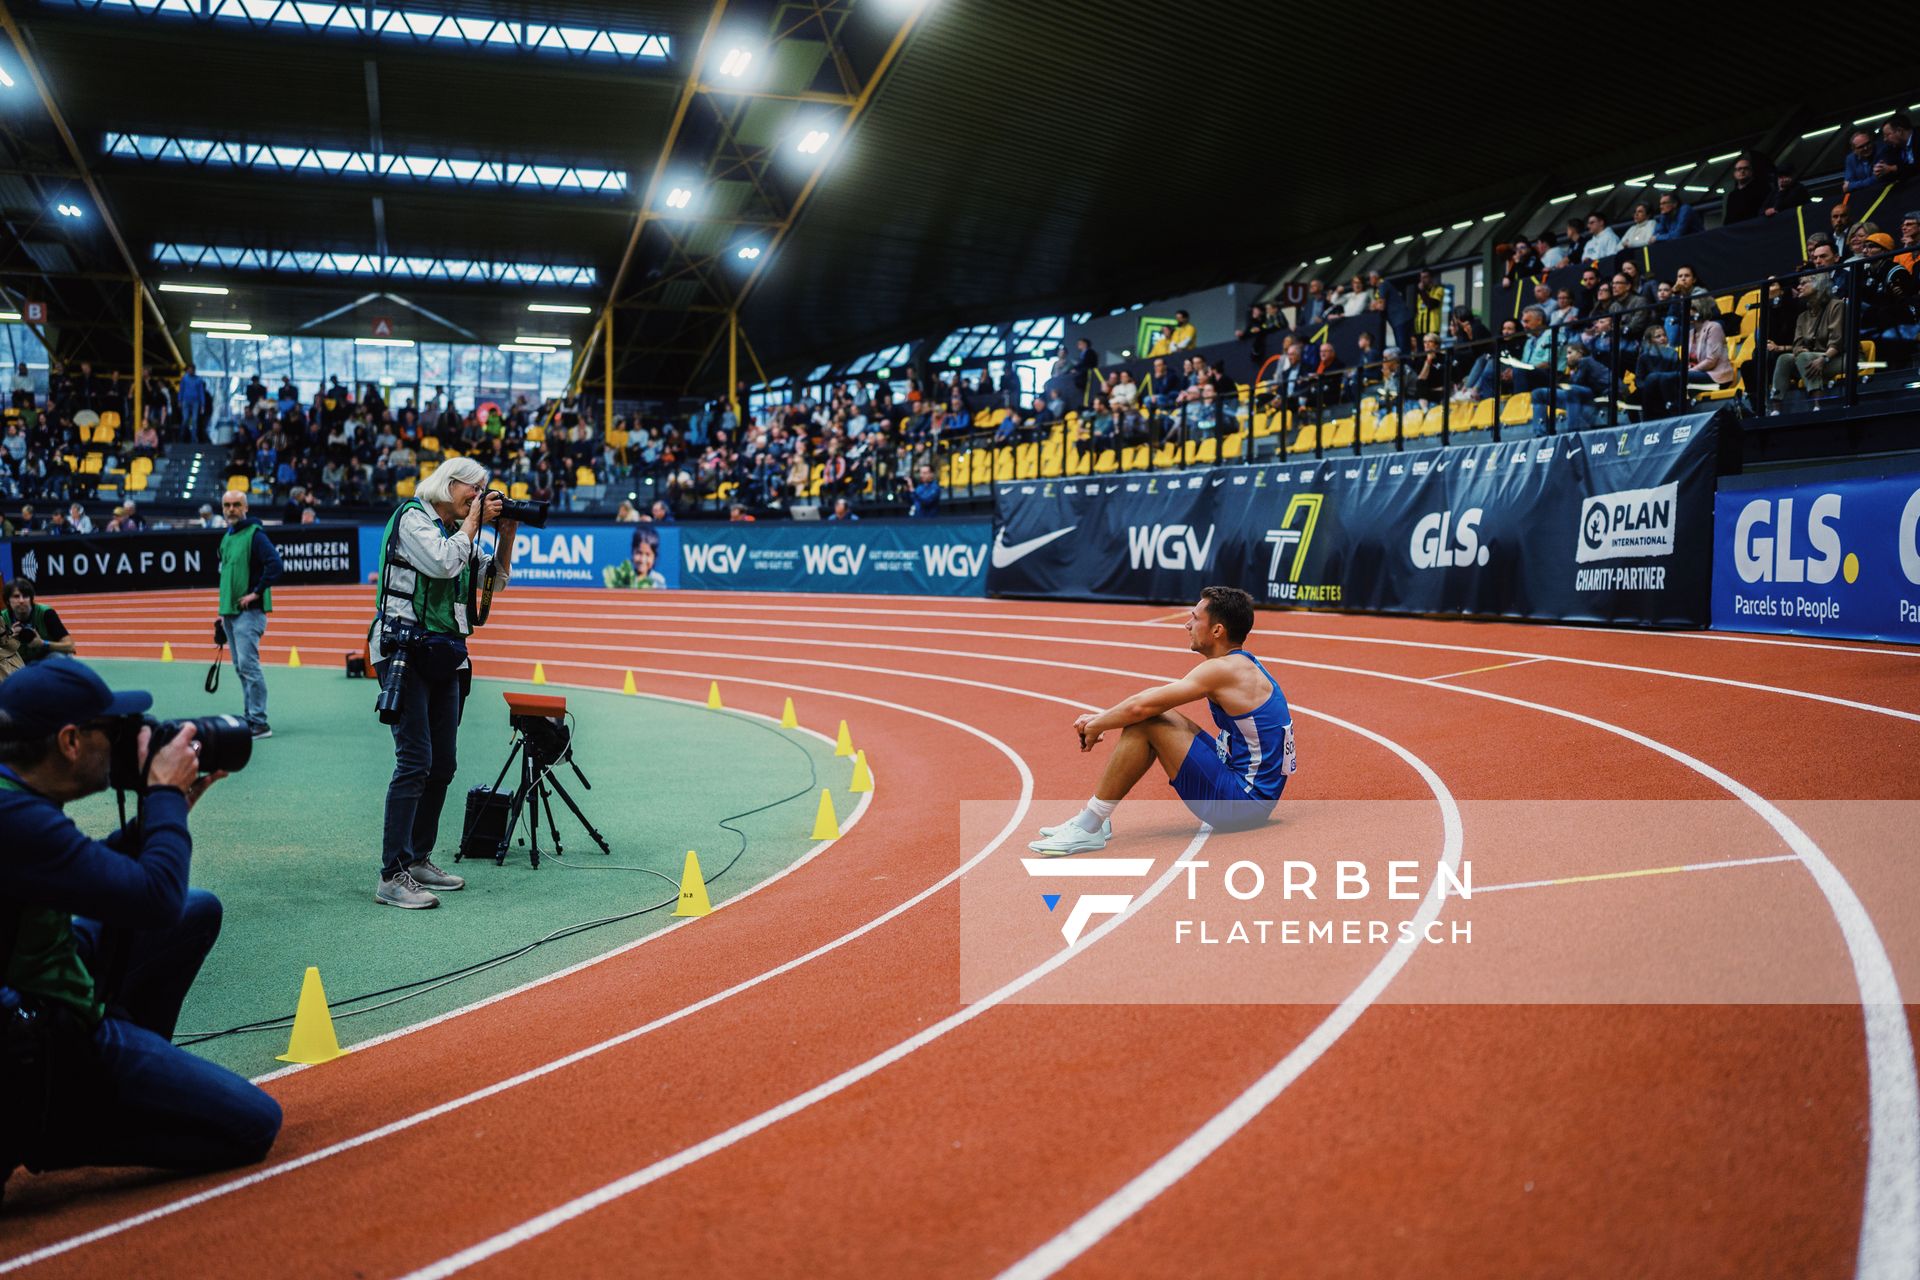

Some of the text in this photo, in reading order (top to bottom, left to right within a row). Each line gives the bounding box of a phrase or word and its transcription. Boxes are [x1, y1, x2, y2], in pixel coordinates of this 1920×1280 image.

[1288, 286, 1303, 303] U
[28, 303, 42, 320] B
[375, 319, 391, 335] A
[1612, 499, 1670, 532] PLAN
[275, 542, 349, 557] CHMERZEN
[511, 534, 593, 565] PLAN
[1128, 523, 1215, 571] WGV
[1410, 507, 1490, 570] GLS.
[1611, 535, 1667, 549] INTERNATIONAL
[1734, 493, 1860, 584] GLS.
[48, 550, 201, 577] NOVAFON
[283, 557, 349, 572] NNUNGEN
[683, 543, 747, 574] WGV
[803, 543, 866, 576] WGV
[923, 543, 988, 577] WGV
[510, 568, 593, 580] INTERNATIONAL
[1575, 566, 1666, 592] CHARITY-PARTNER
[1735, 595, 1840, 624] Parcels to People
